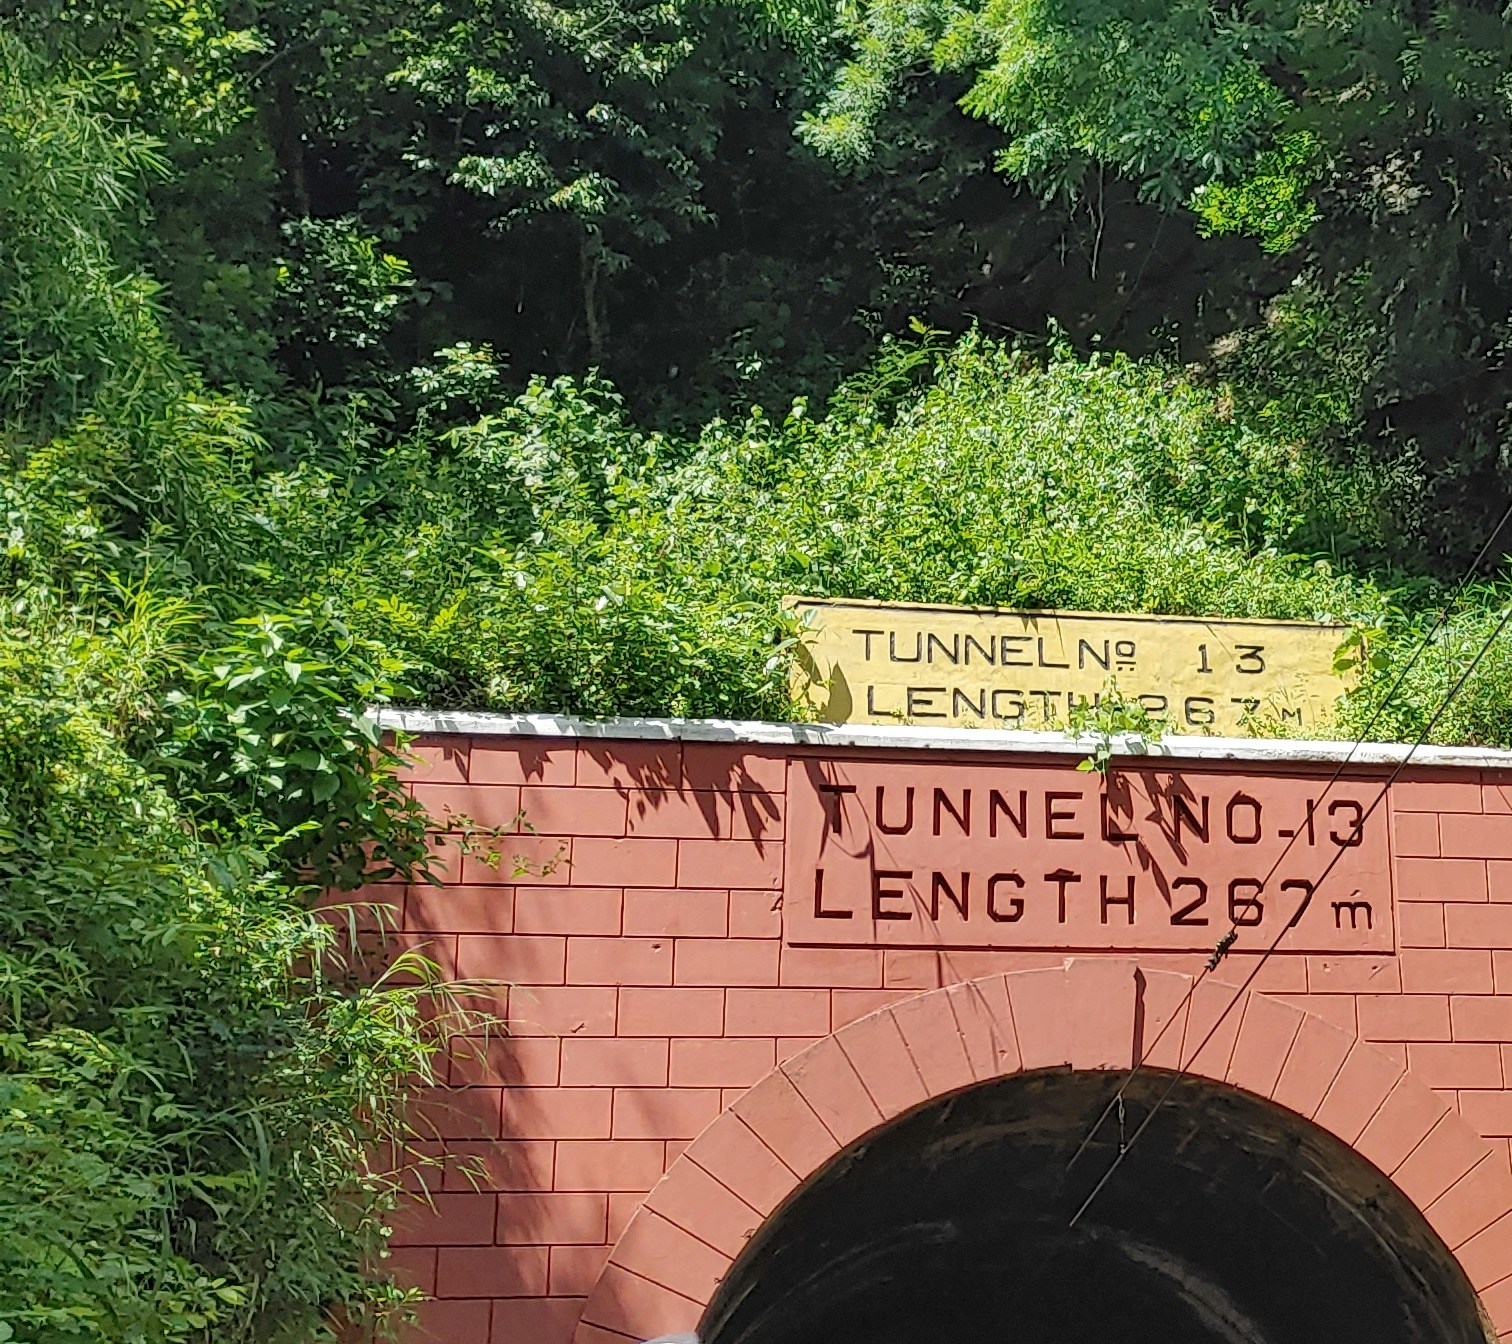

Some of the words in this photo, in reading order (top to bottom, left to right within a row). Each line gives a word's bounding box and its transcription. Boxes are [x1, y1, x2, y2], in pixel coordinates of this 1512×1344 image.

[852, 629, 1070, 669] TUNNEL
[1197, 643, 1266, 674] 13
[867, 685, 1101, 720] LENGTH
[819, 783, 1139, 842] TUNNEL
[813, 867, 1136, 925] LENGTH
[1170, 876, 1314, 928] 267
